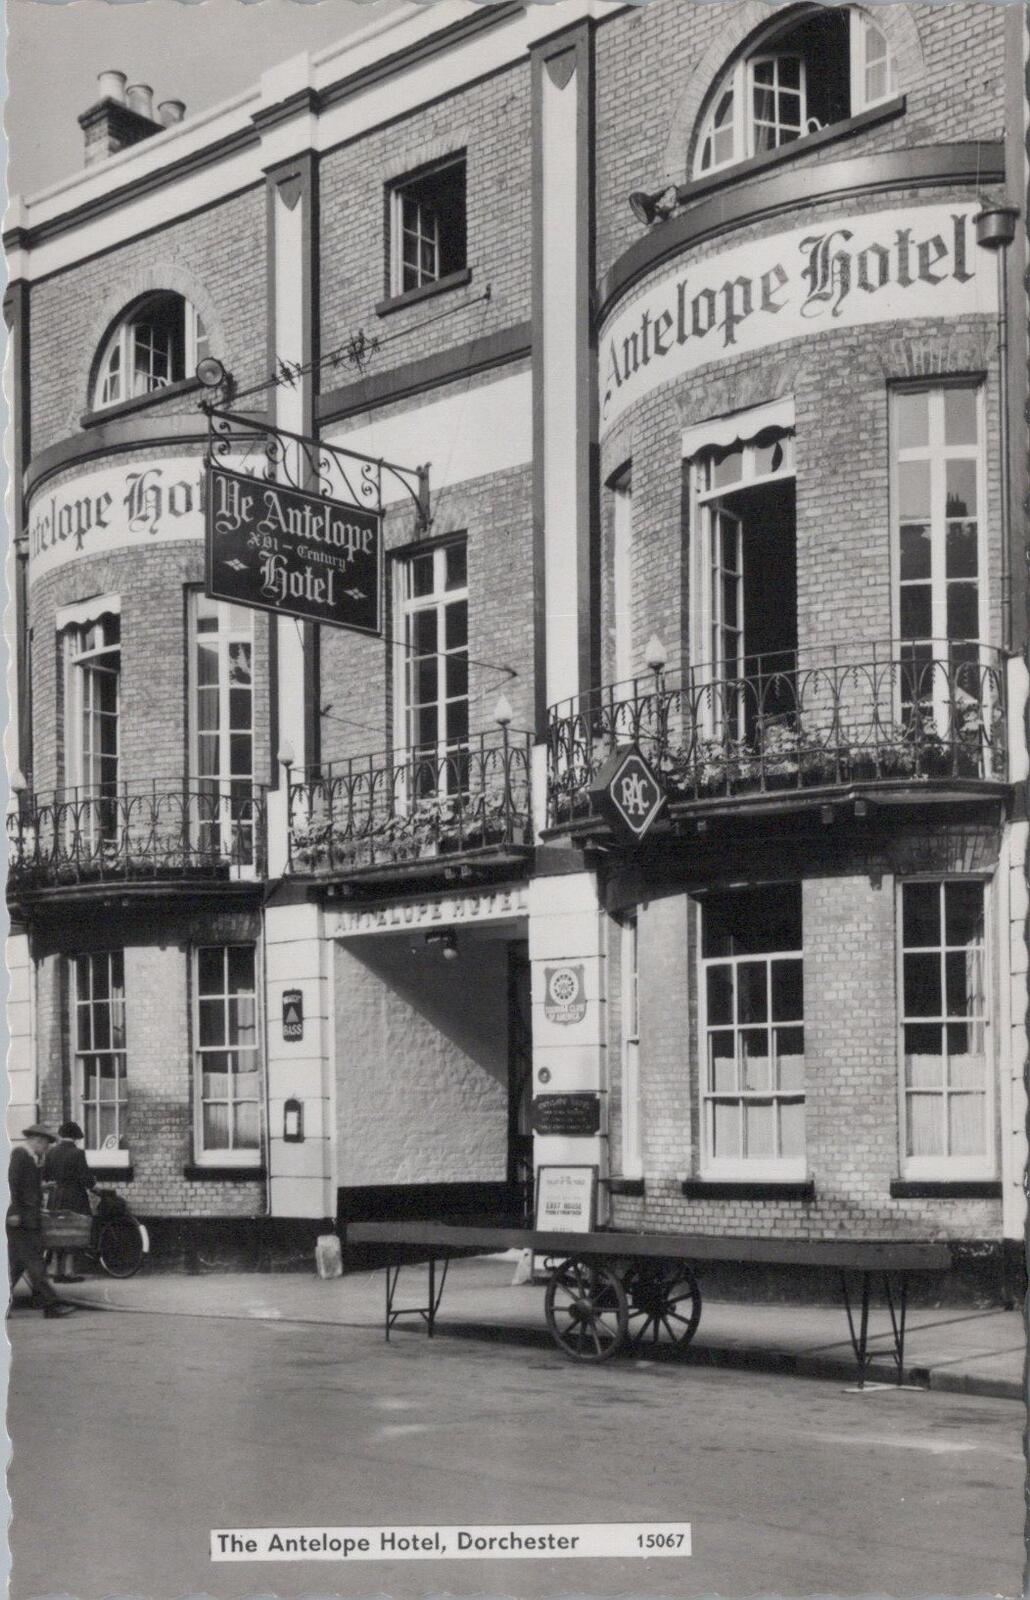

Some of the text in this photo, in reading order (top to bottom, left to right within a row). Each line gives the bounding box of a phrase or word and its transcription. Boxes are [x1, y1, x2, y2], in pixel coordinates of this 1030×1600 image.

[603, 214, 975, 420] Antelope Hotel
[215, 476, 374, 563] Ye Antelope
[259, 550, 337, 606] Hotel
[297, 545, 346, 573] Century
[621, 773, 650, 815] RAC
[335, 889, 528, 932] ANTELOPE HOTEL
